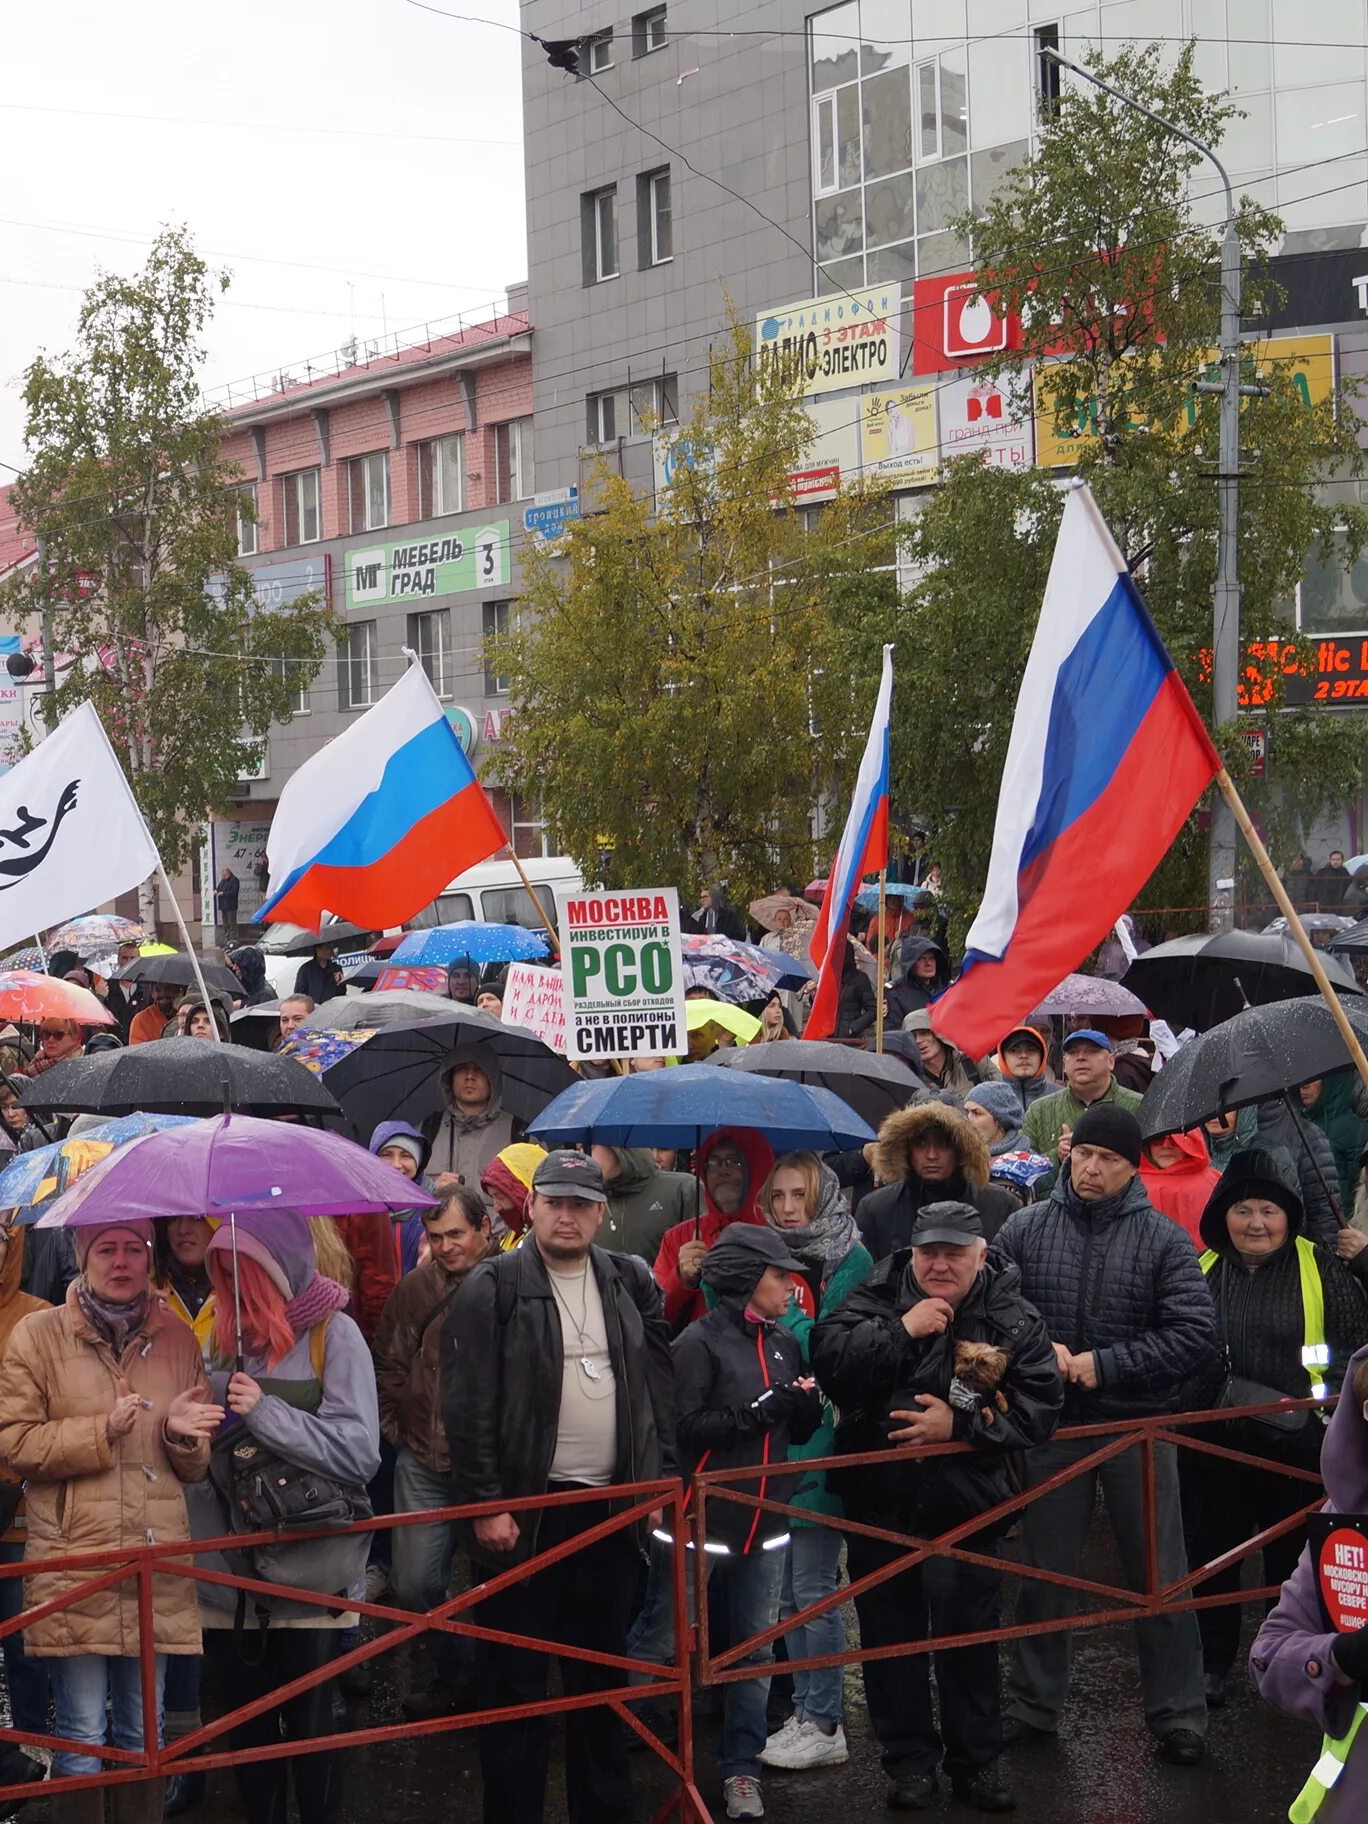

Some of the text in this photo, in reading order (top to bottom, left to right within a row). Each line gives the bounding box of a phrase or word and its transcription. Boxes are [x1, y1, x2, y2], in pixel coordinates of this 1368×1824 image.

[788, 297, 888, 331] РАДИОФОН
[822, 318, 888, 346] 3 ЭТАЖ
[878, 461, 903, 470] Выход
[393, 538, 463, 570] МЕБЕЛЬ
[482, 543, 495, 576] 3
[391, 568, 435, 596] ГРАД
[1314, 681, 1330, 699] 2
[567, 896, 668, 924] МОСКВА
[623, 999, 641, 1008] СБОР
[643, 998, 674, 1006] ОТХОДОВ
[575, 1017, 582, 1026] а
[585, 1015, 600, 1026] не
[613, 1011, 675, 1025] полигоны
[576, 1023, 677, 1053] СМЕРТИ
[1335, 1543, 1365, 1569] НЕТ!
[1331, 1578, 1361, 1596] МУСОРУ
[1338, 1592, 1368, 1610] СЕВЕРЕ
